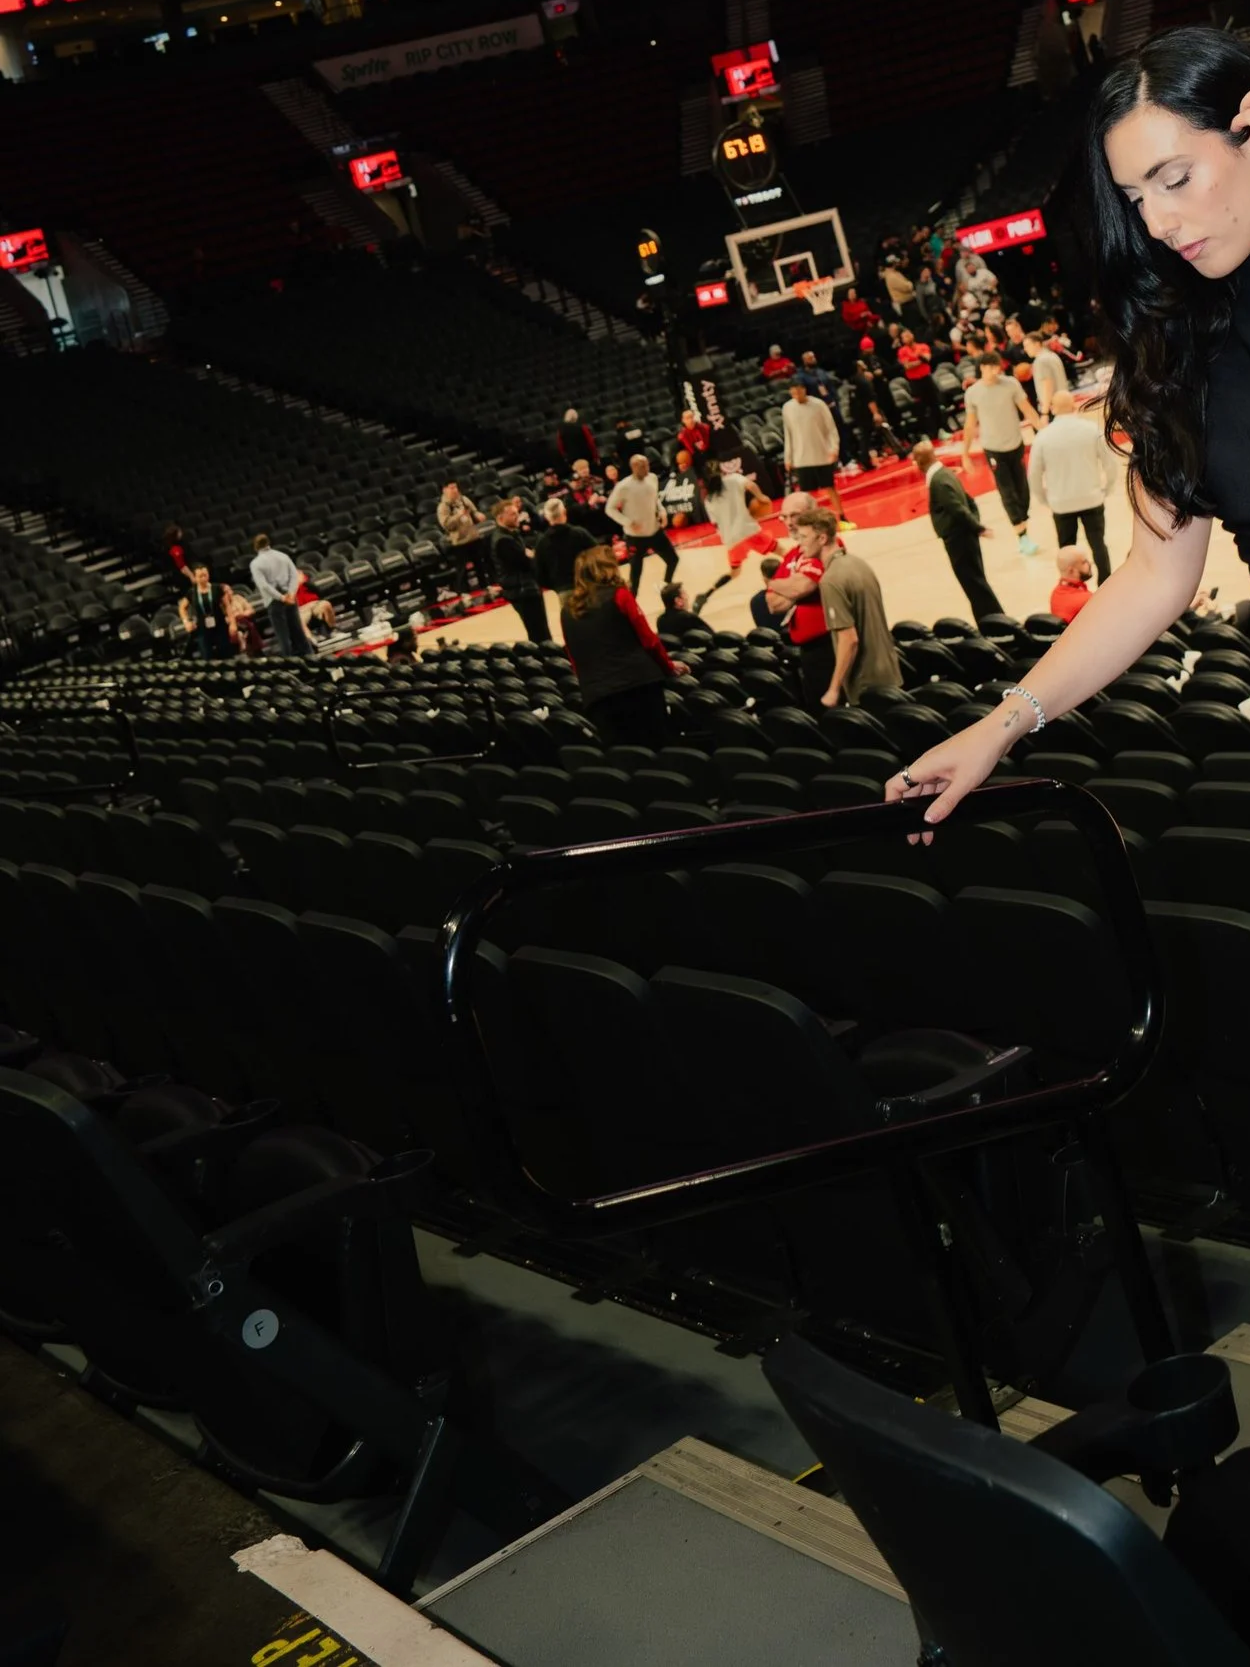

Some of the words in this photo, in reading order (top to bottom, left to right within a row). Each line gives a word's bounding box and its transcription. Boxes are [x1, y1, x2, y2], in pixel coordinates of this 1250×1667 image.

[404, 47, 432, 70] RIP
[435, 38, 475, 61] CITY
[478, 28, 518, 51] ROW
[254, 1319, 265, 1337] F
